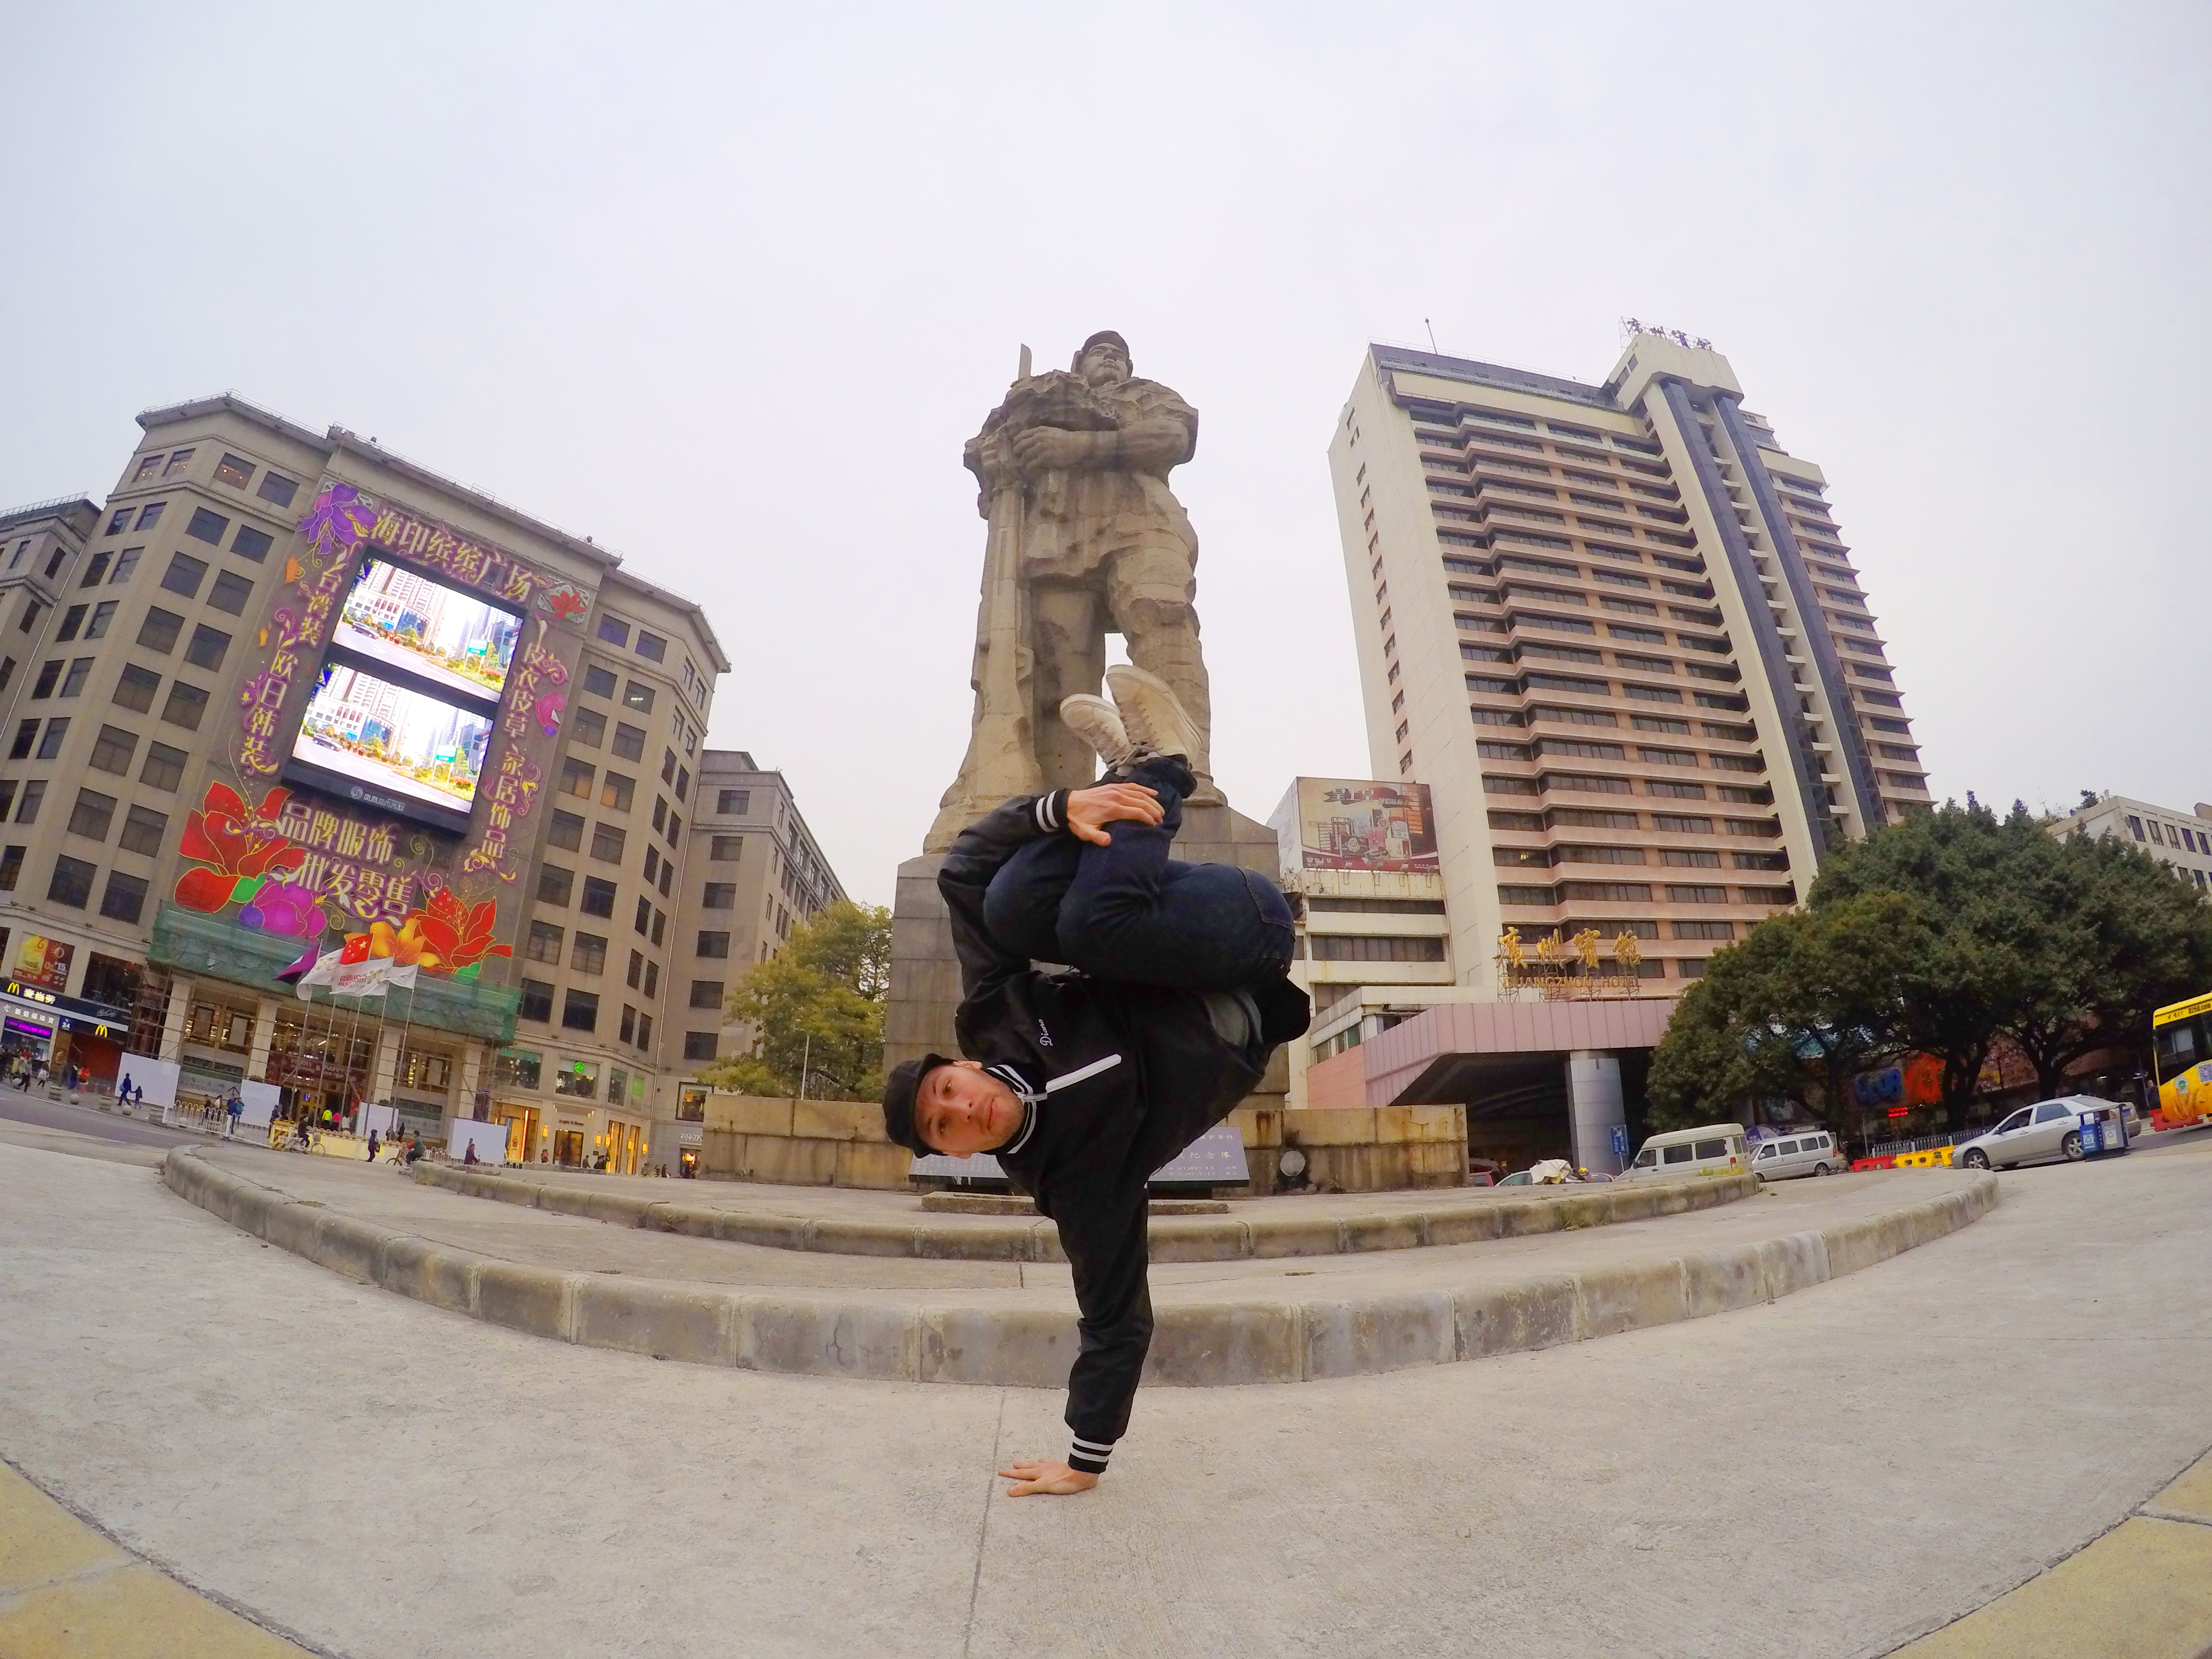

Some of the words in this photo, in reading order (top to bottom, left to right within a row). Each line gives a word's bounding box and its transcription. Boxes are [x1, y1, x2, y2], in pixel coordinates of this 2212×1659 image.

[371, 511, 531, 603] 海印缤缤广场
[276, 802, 395, 865] 品牌服饰
[296, 852, 413, 916] 批发零售
[1503, 976, 1593, 989] GUANGZHOU
[1601, 976, 1642, 988] HOTEL
[1038, 1019, 1053, 1046] Diana
